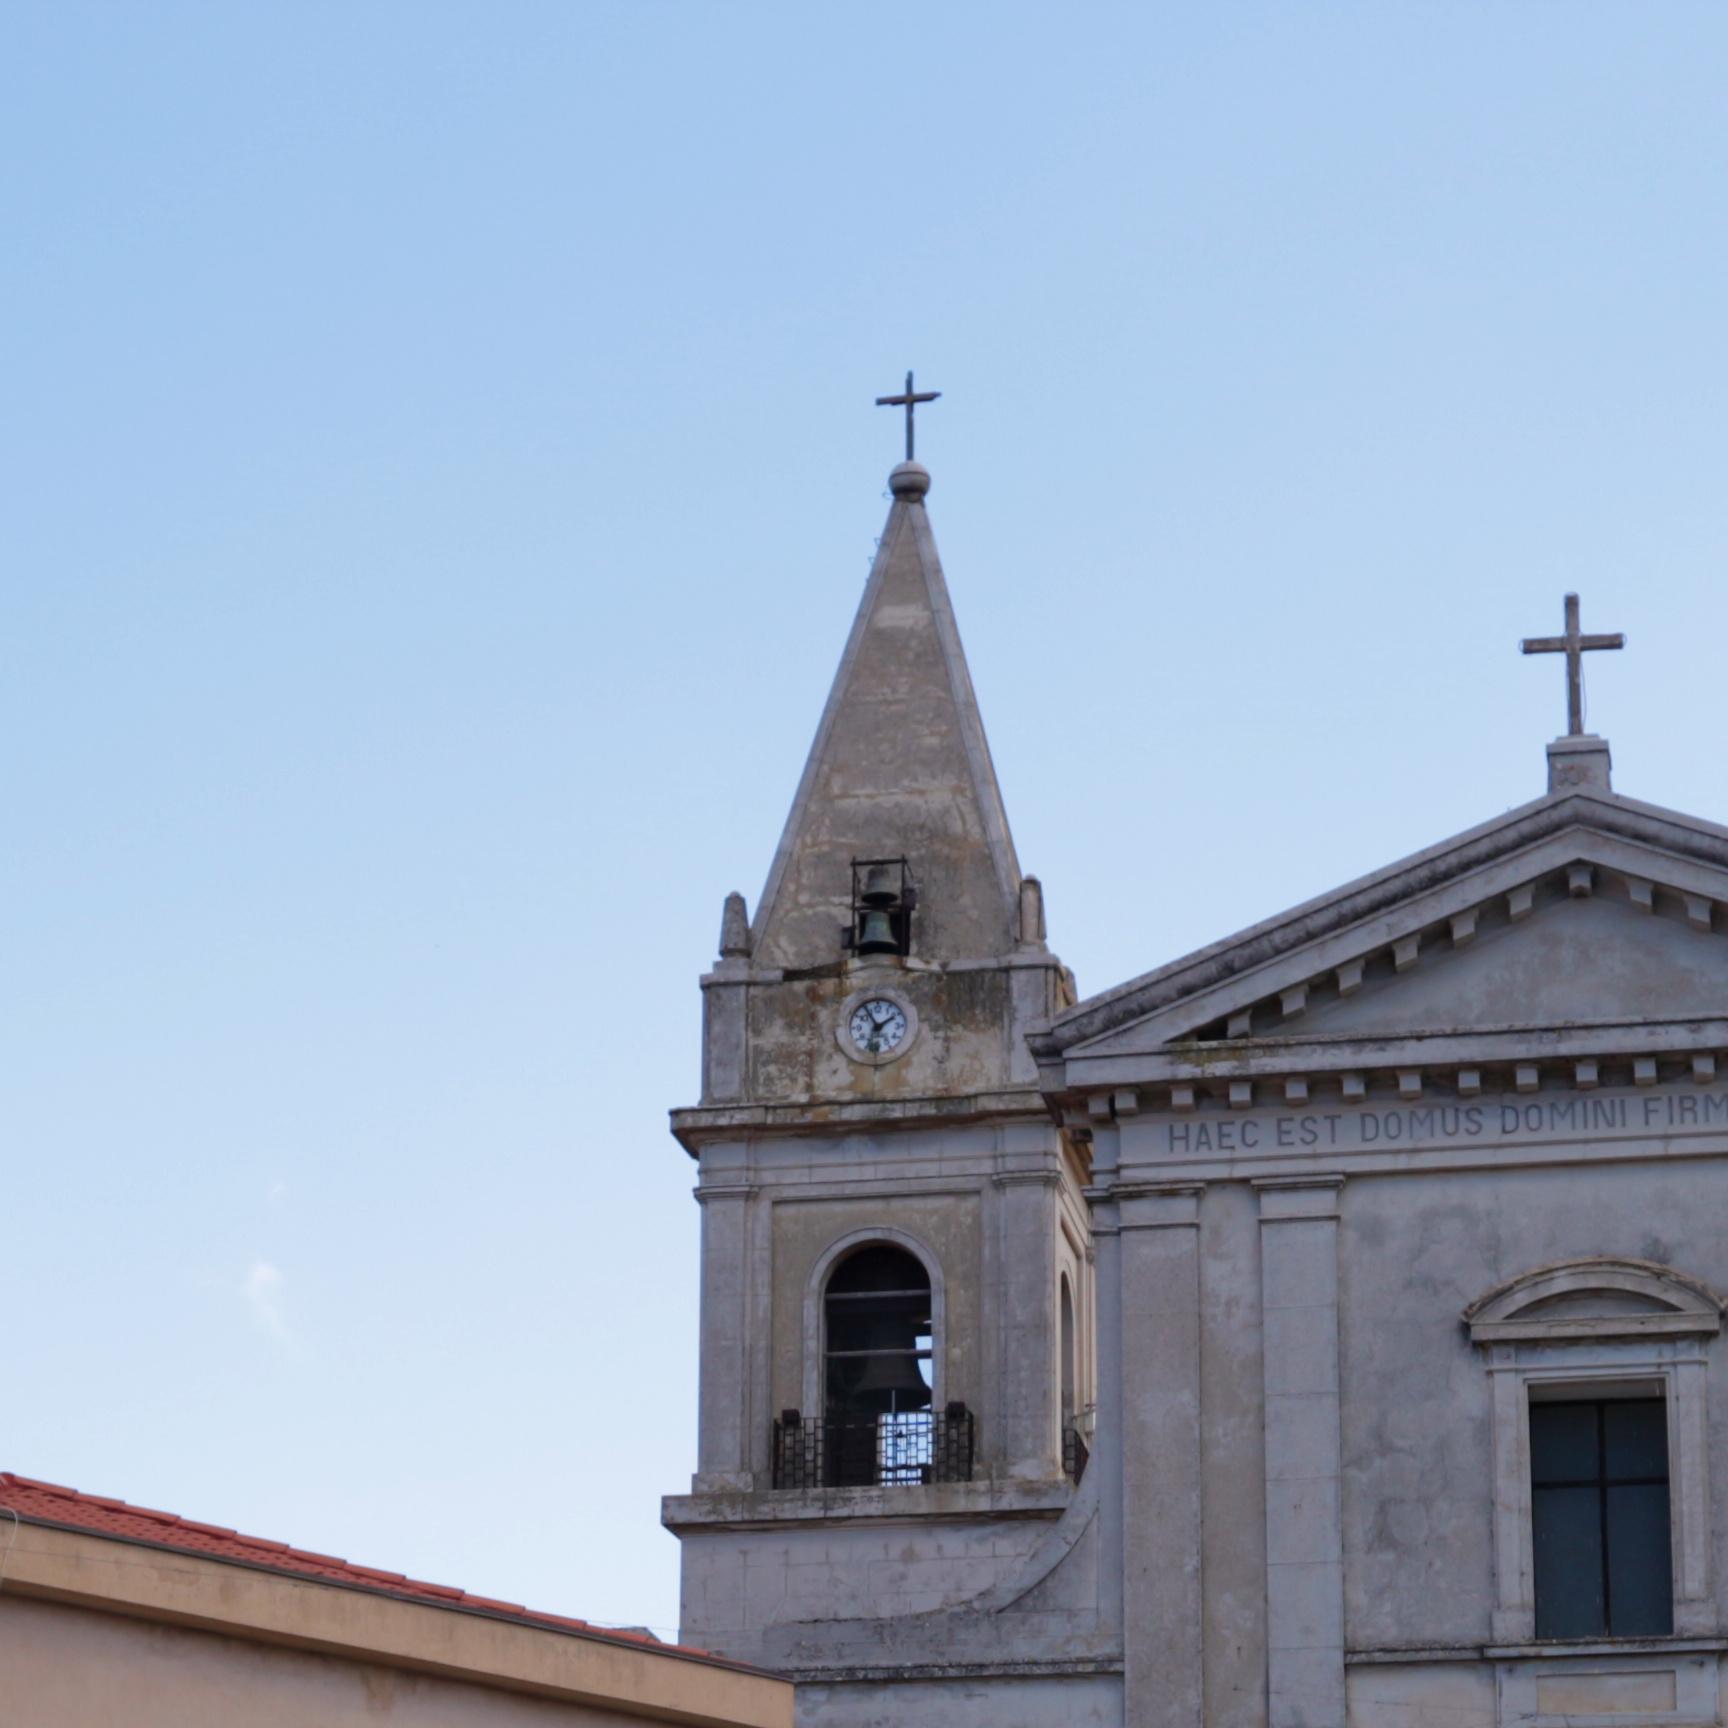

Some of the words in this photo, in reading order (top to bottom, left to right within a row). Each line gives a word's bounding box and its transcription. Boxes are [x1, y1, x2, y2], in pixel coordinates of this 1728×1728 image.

[1168, 1119, 1260, 1153] HAEC
[1277, 1114, 1342, 1147] EST
[1360, 1106, 1483, 1143] DOMUS
[1502, 1098, 1626, 1135] DOMINI
